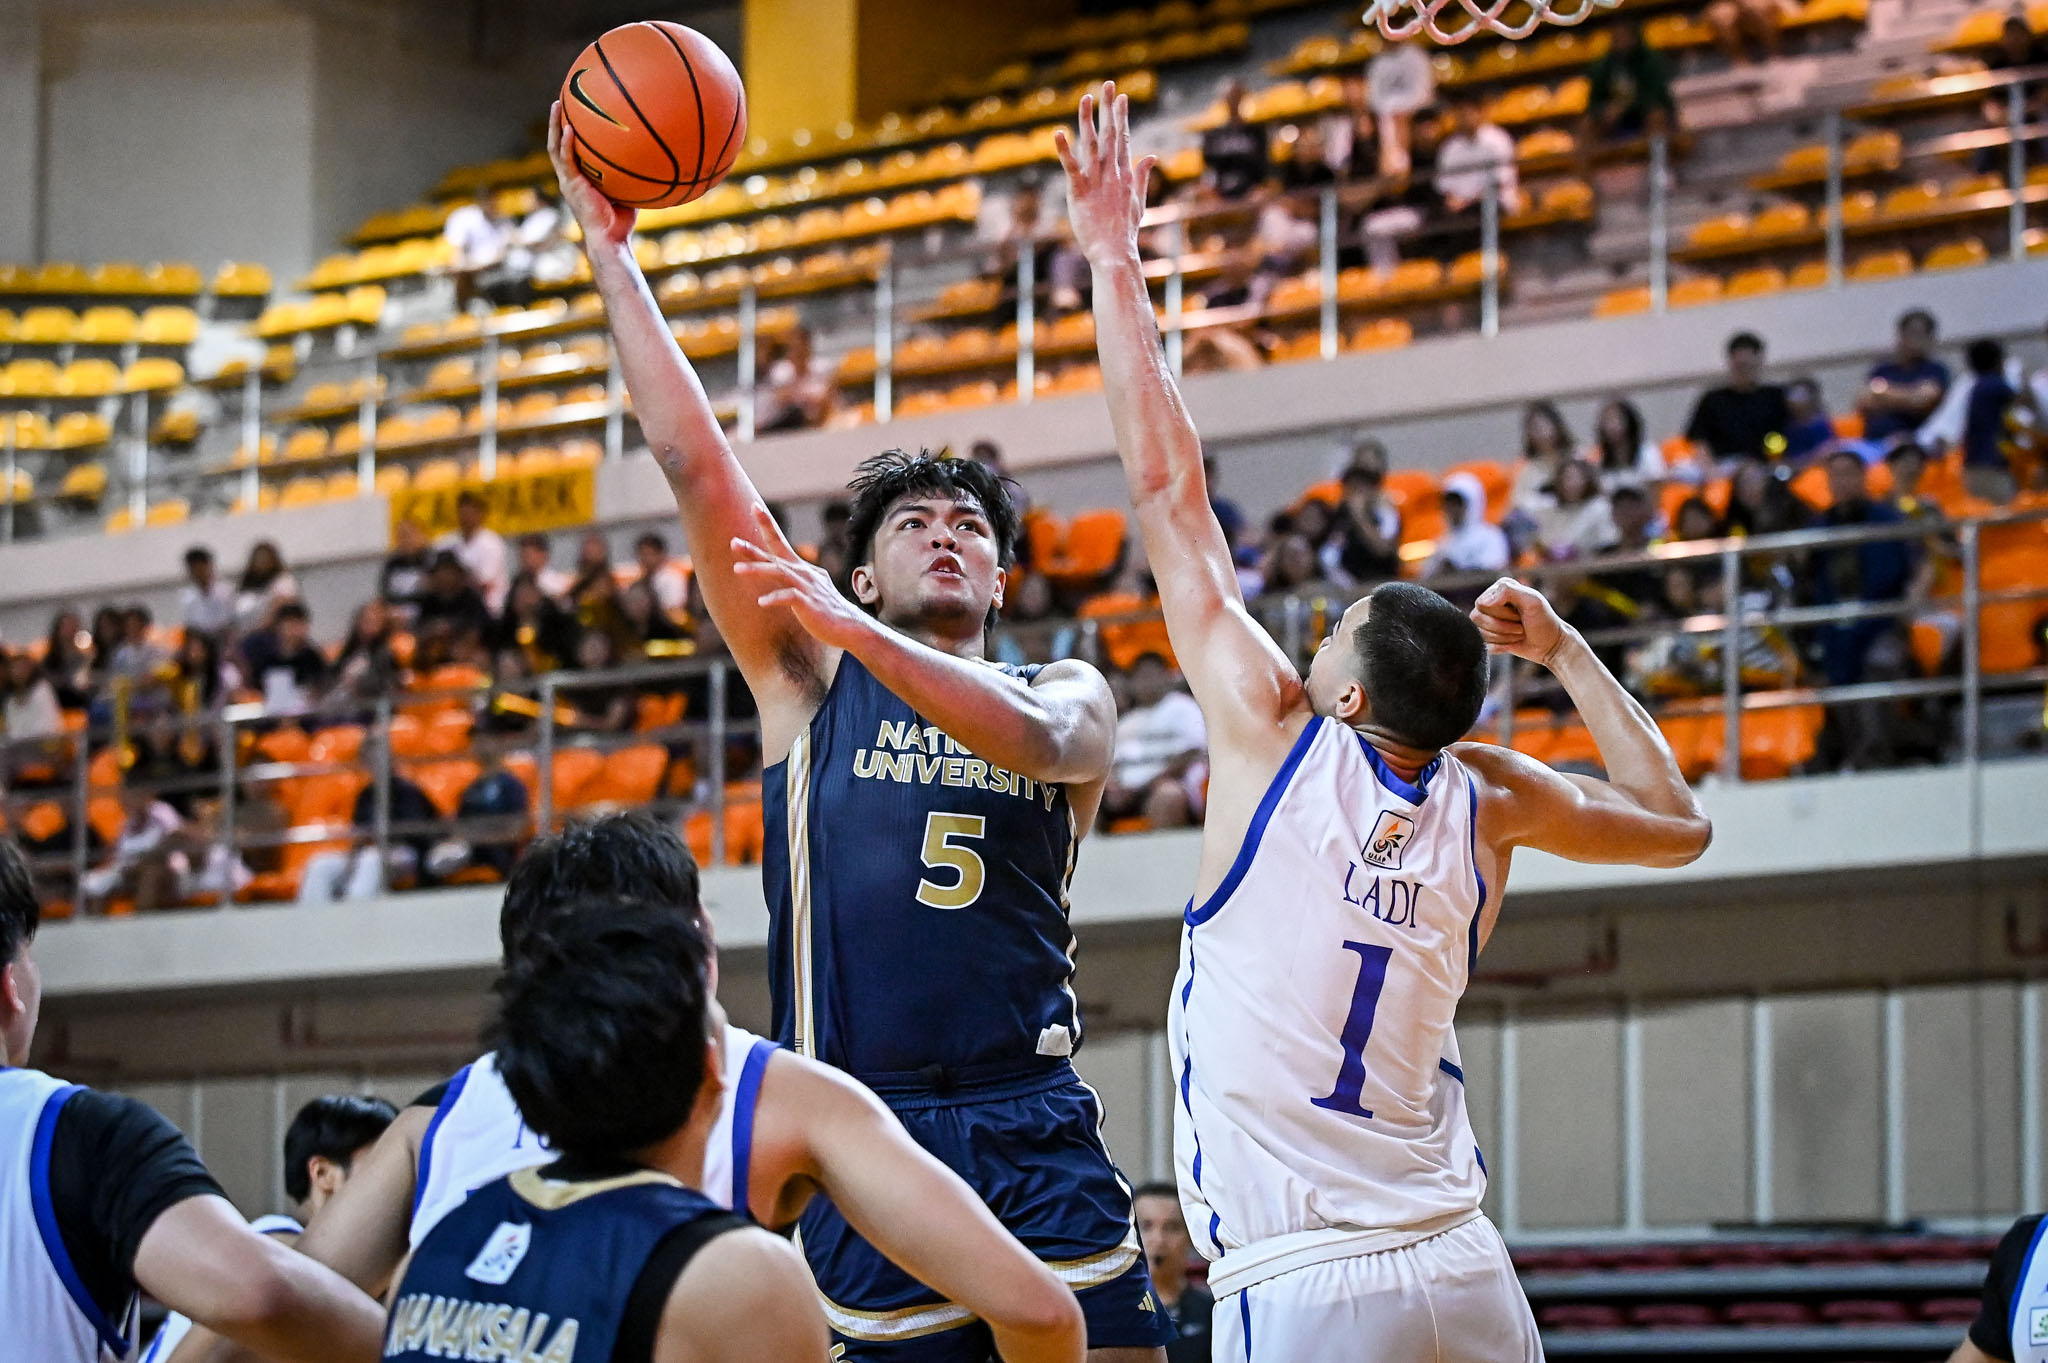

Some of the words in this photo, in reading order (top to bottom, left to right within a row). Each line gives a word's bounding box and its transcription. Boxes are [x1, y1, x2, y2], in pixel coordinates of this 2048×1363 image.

[876, 720, 972, 756] NATI
[852, 748, 1058, 812] UNIVERSITY
[914, 811, 987, 910] 5
[1343, 860, 1424, 929] LADI
[1310, 939, 1394, 1119] 1
